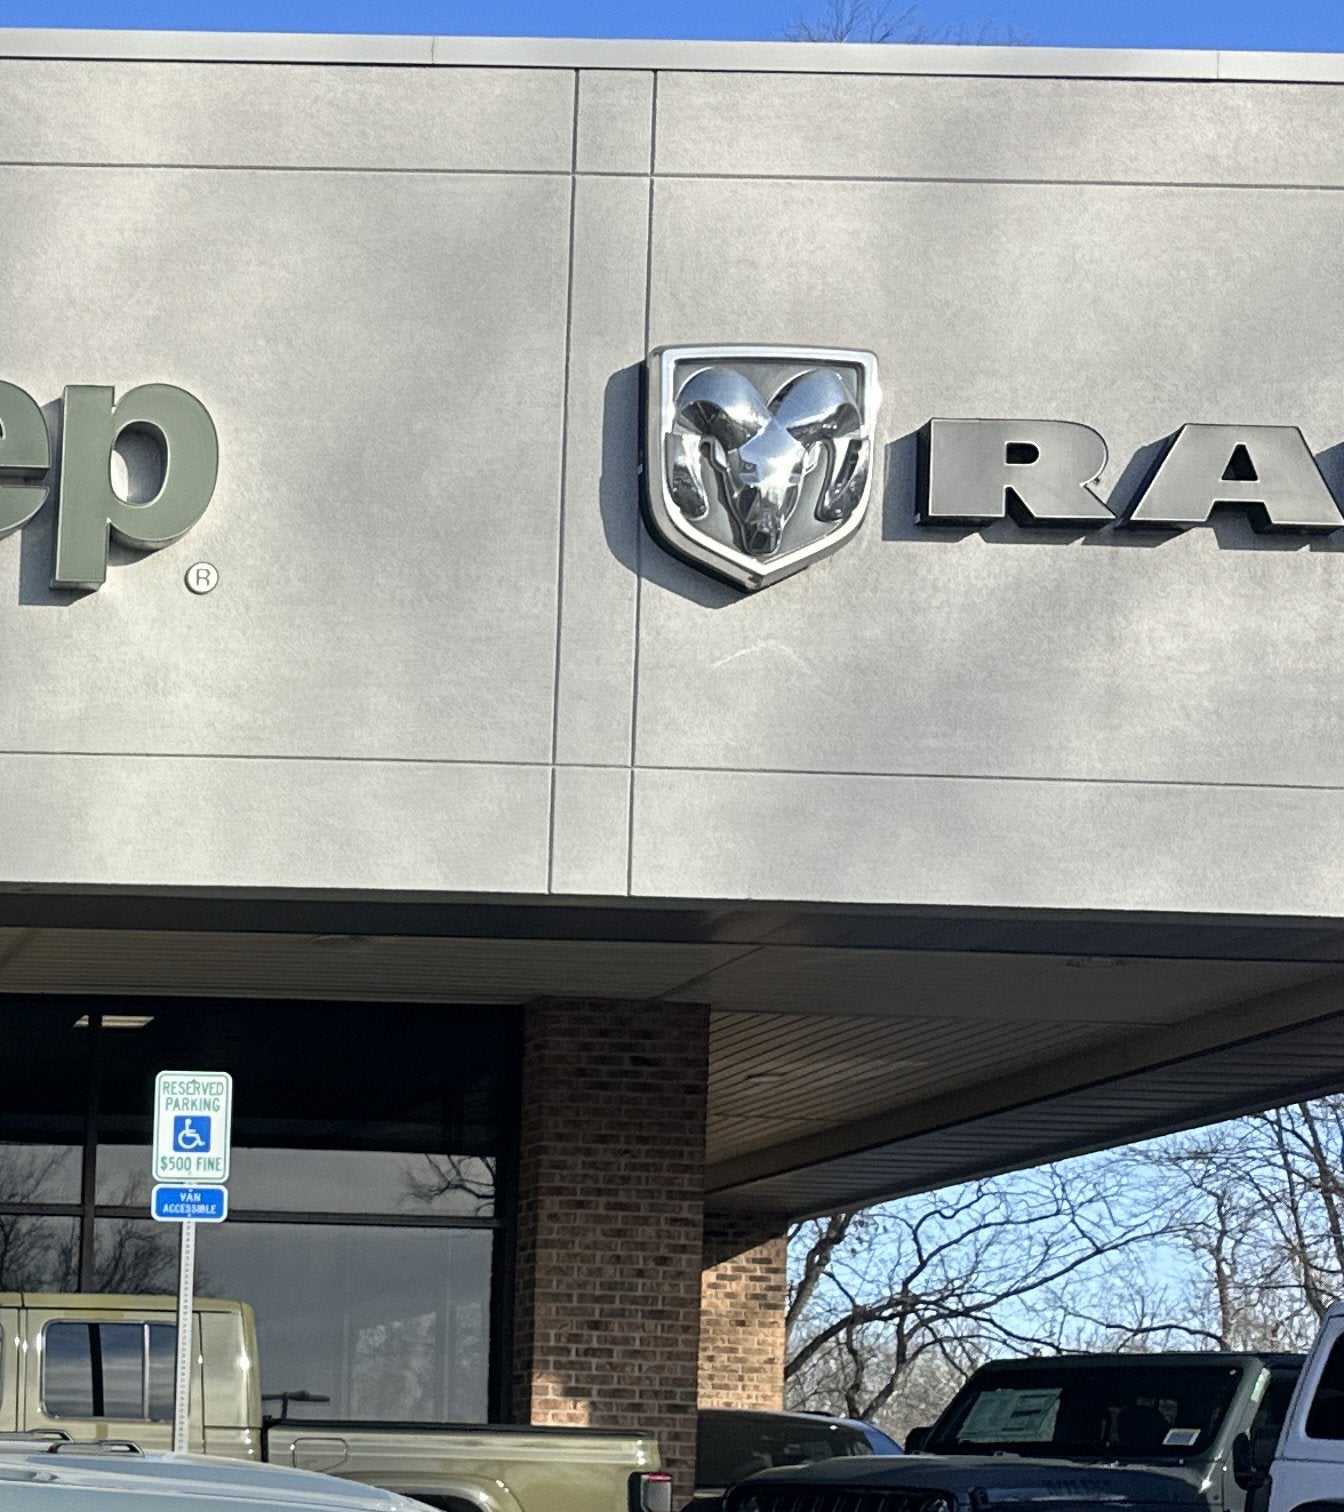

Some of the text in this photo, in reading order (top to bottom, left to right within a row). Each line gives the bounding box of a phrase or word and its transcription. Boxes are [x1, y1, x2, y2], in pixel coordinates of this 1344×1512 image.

[924, 417, 1344, 533] RA
[162, 1080, 225, 1096] RESERVED
[165, 1097, 221, 1112] PARKING
[160, 1156, 223, 1172] $500 FINE
[179, 1192, 202, 1202] VAN
[162, 1203, 217, 1215] ACCESSIBLE
